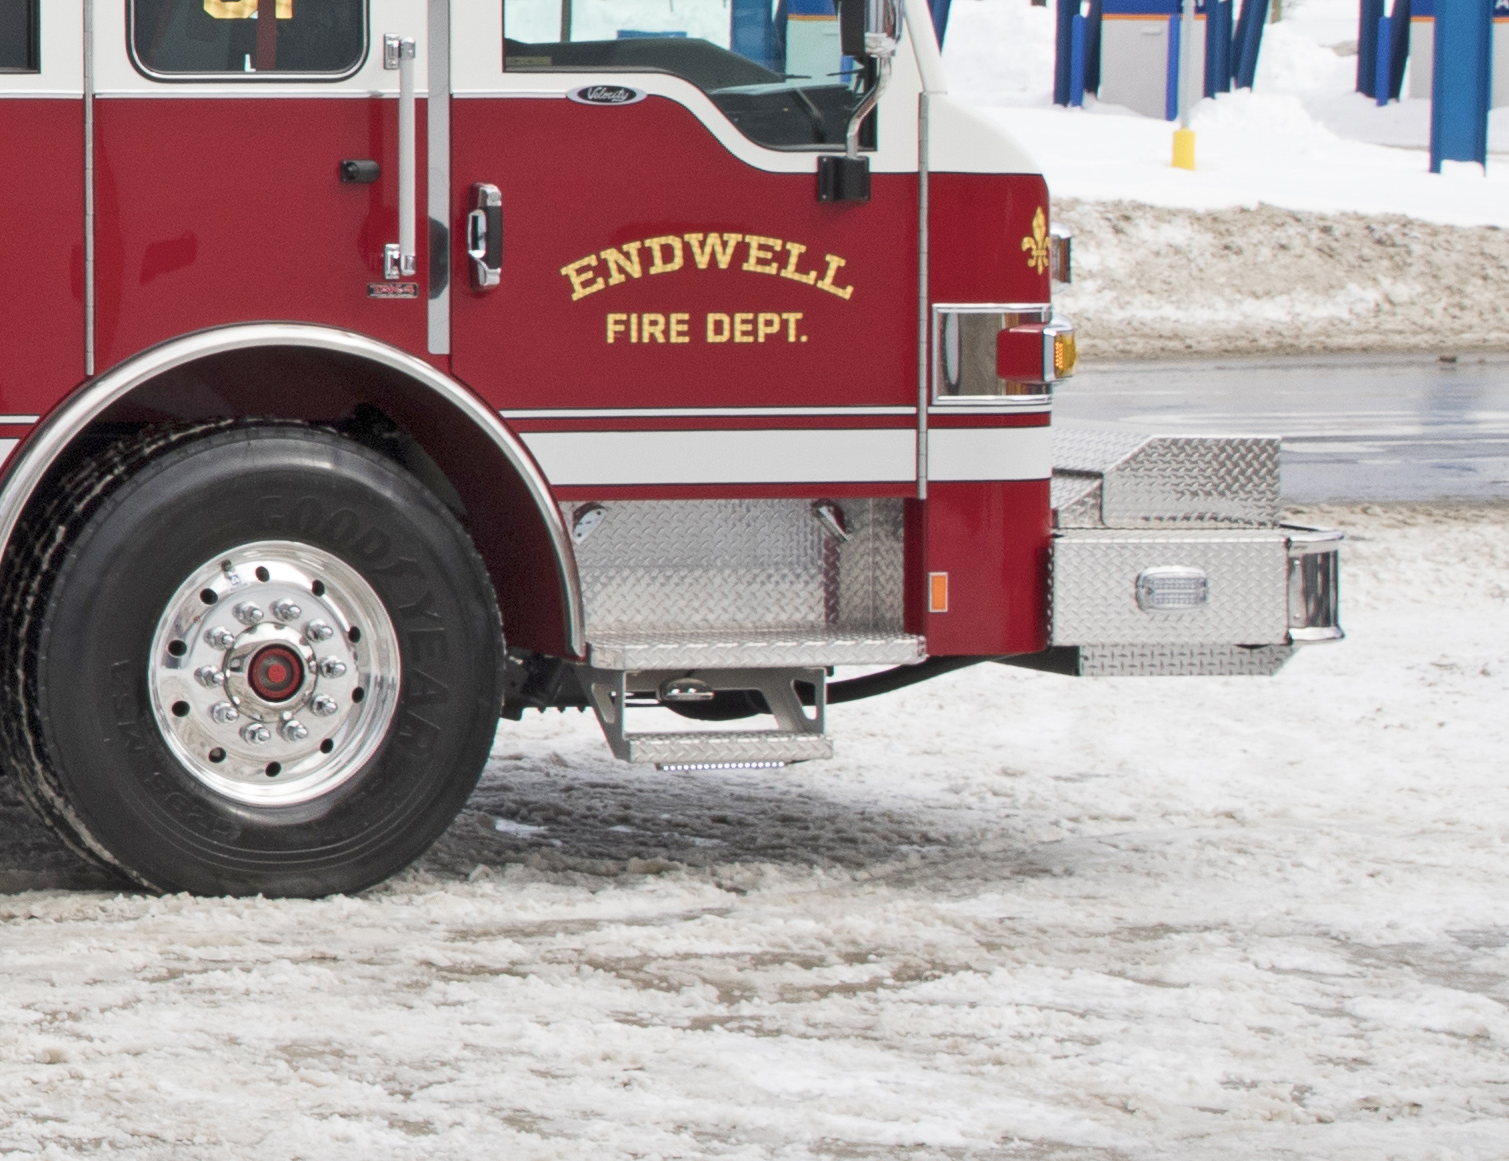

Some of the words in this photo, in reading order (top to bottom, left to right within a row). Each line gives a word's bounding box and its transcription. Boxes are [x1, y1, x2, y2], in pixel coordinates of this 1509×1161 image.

[587, 87, 629, 103] Velocity
[560, 232, 854, 301] ENDWELL
[607, 313, 690, 344] FIRE
[707, 312, 808, 344] DEPT.
[249, 493, 450, 758] GOODYEAR
